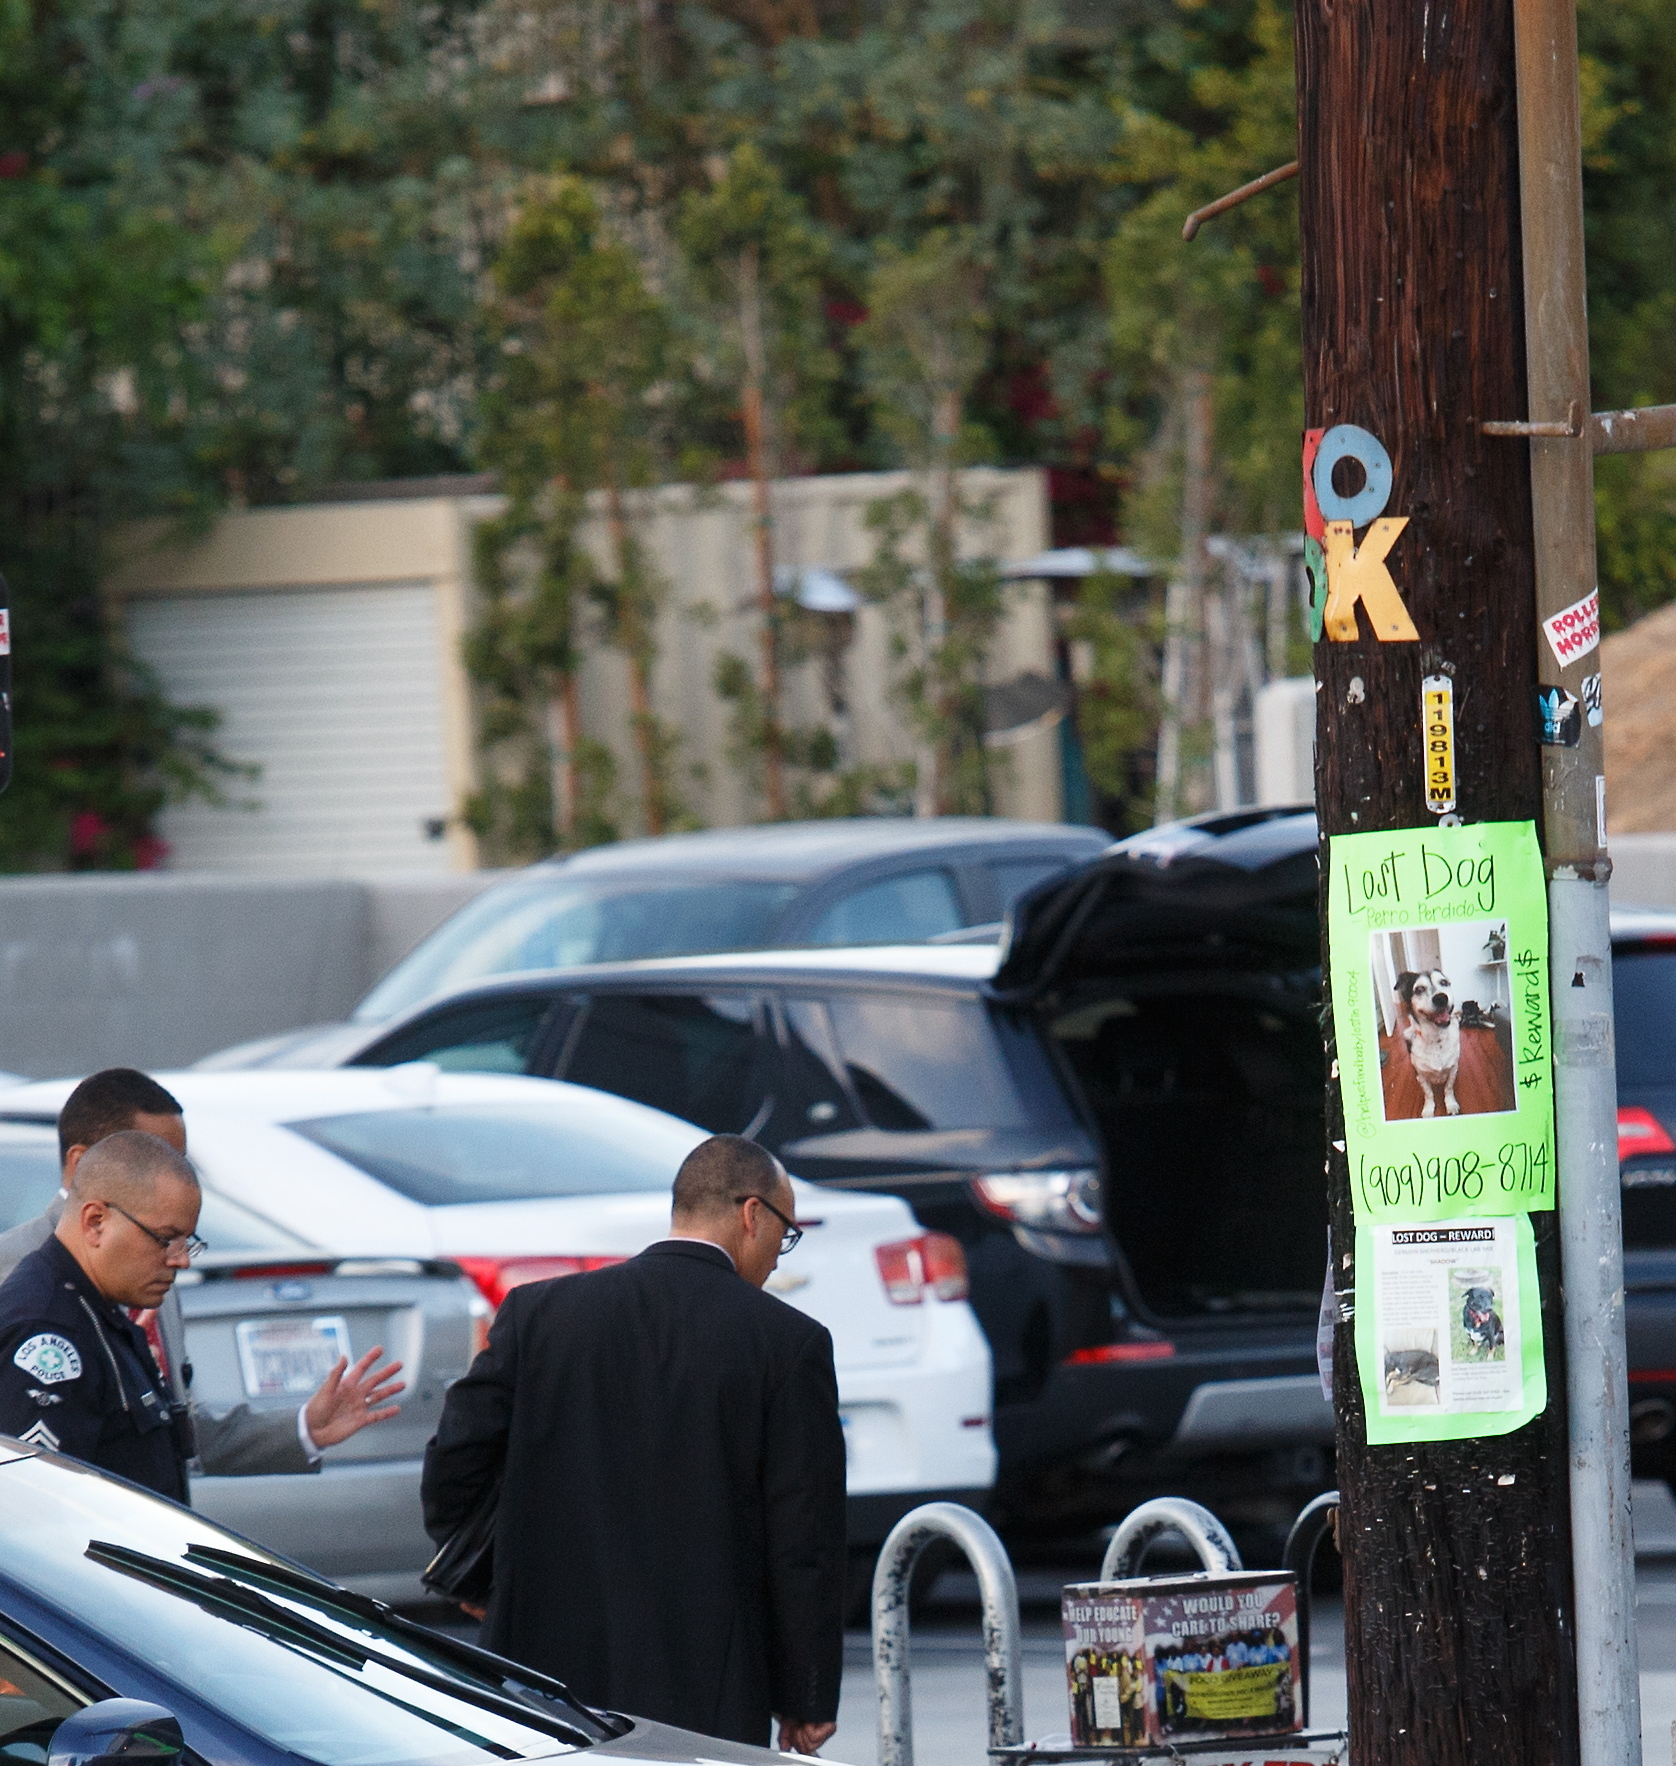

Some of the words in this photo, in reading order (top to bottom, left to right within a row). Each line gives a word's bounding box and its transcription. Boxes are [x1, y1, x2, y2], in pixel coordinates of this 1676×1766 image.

[1429, 693, 1452, 800] 119813M
[1421, 843, 1494, 912] Dog
[1392, 1232, 1414, 1244] LOST
[1416, 1231, 1438, 1242] DOG
[18, 1341, 37, 1361] LOS
[31, 1365, 65, 1380] POLICE
[1182, 1595, 1234, 1615] WOULD
[1237, 1592, 1264, 1609] YOU
[1171, 1618, 1208, 1638] CARE
[1210, 1616, 1226, 1633] TO
[1229, 1611, 1281, 1631] SHARE?
